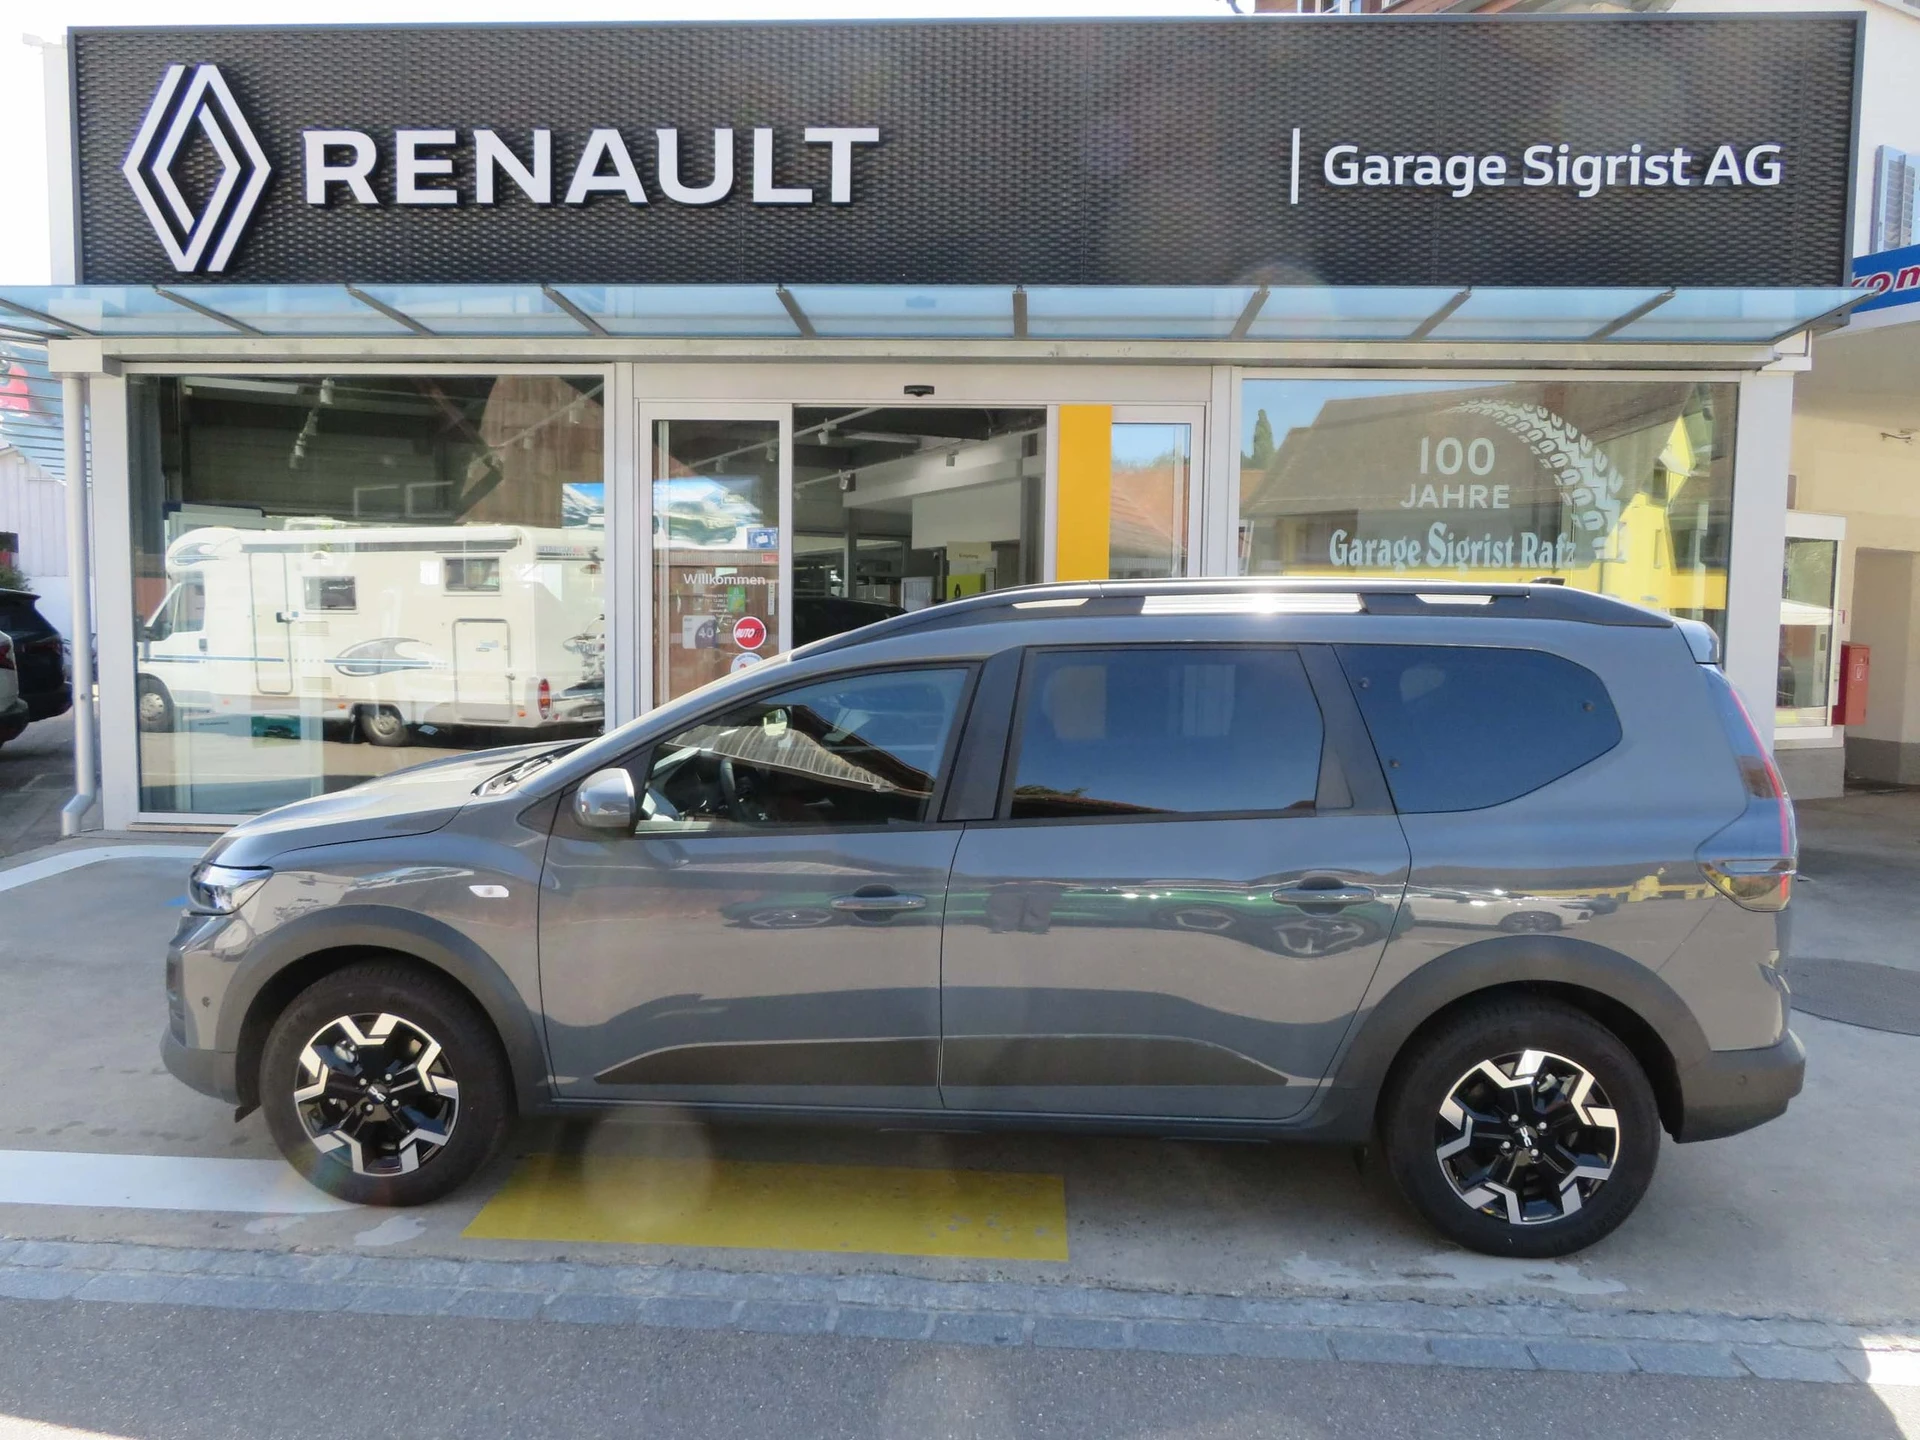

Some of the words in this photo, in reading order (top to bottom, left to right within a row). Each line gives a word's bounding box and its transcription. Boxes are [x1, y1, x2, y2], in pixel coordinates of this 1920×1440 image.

[302, 127, 880, 205] RENAULT
[1324, 144, 1507, 198] Garage
[1523, 143, 1691, 198] Sigrist
[1704, 144, 1782, 186] AG
[1419, 436, 1496, 476] 100
[1400, 483, 1511, 510] JAHRE
[1329, 528, 1422, 575] Garage
[1426, 521, 1515, 575] Sigrist
[1520, 531, 1577, 571] Rafz
[683, 573, 766, 586] Willkommen
[698, 627, 715, 639] 40
